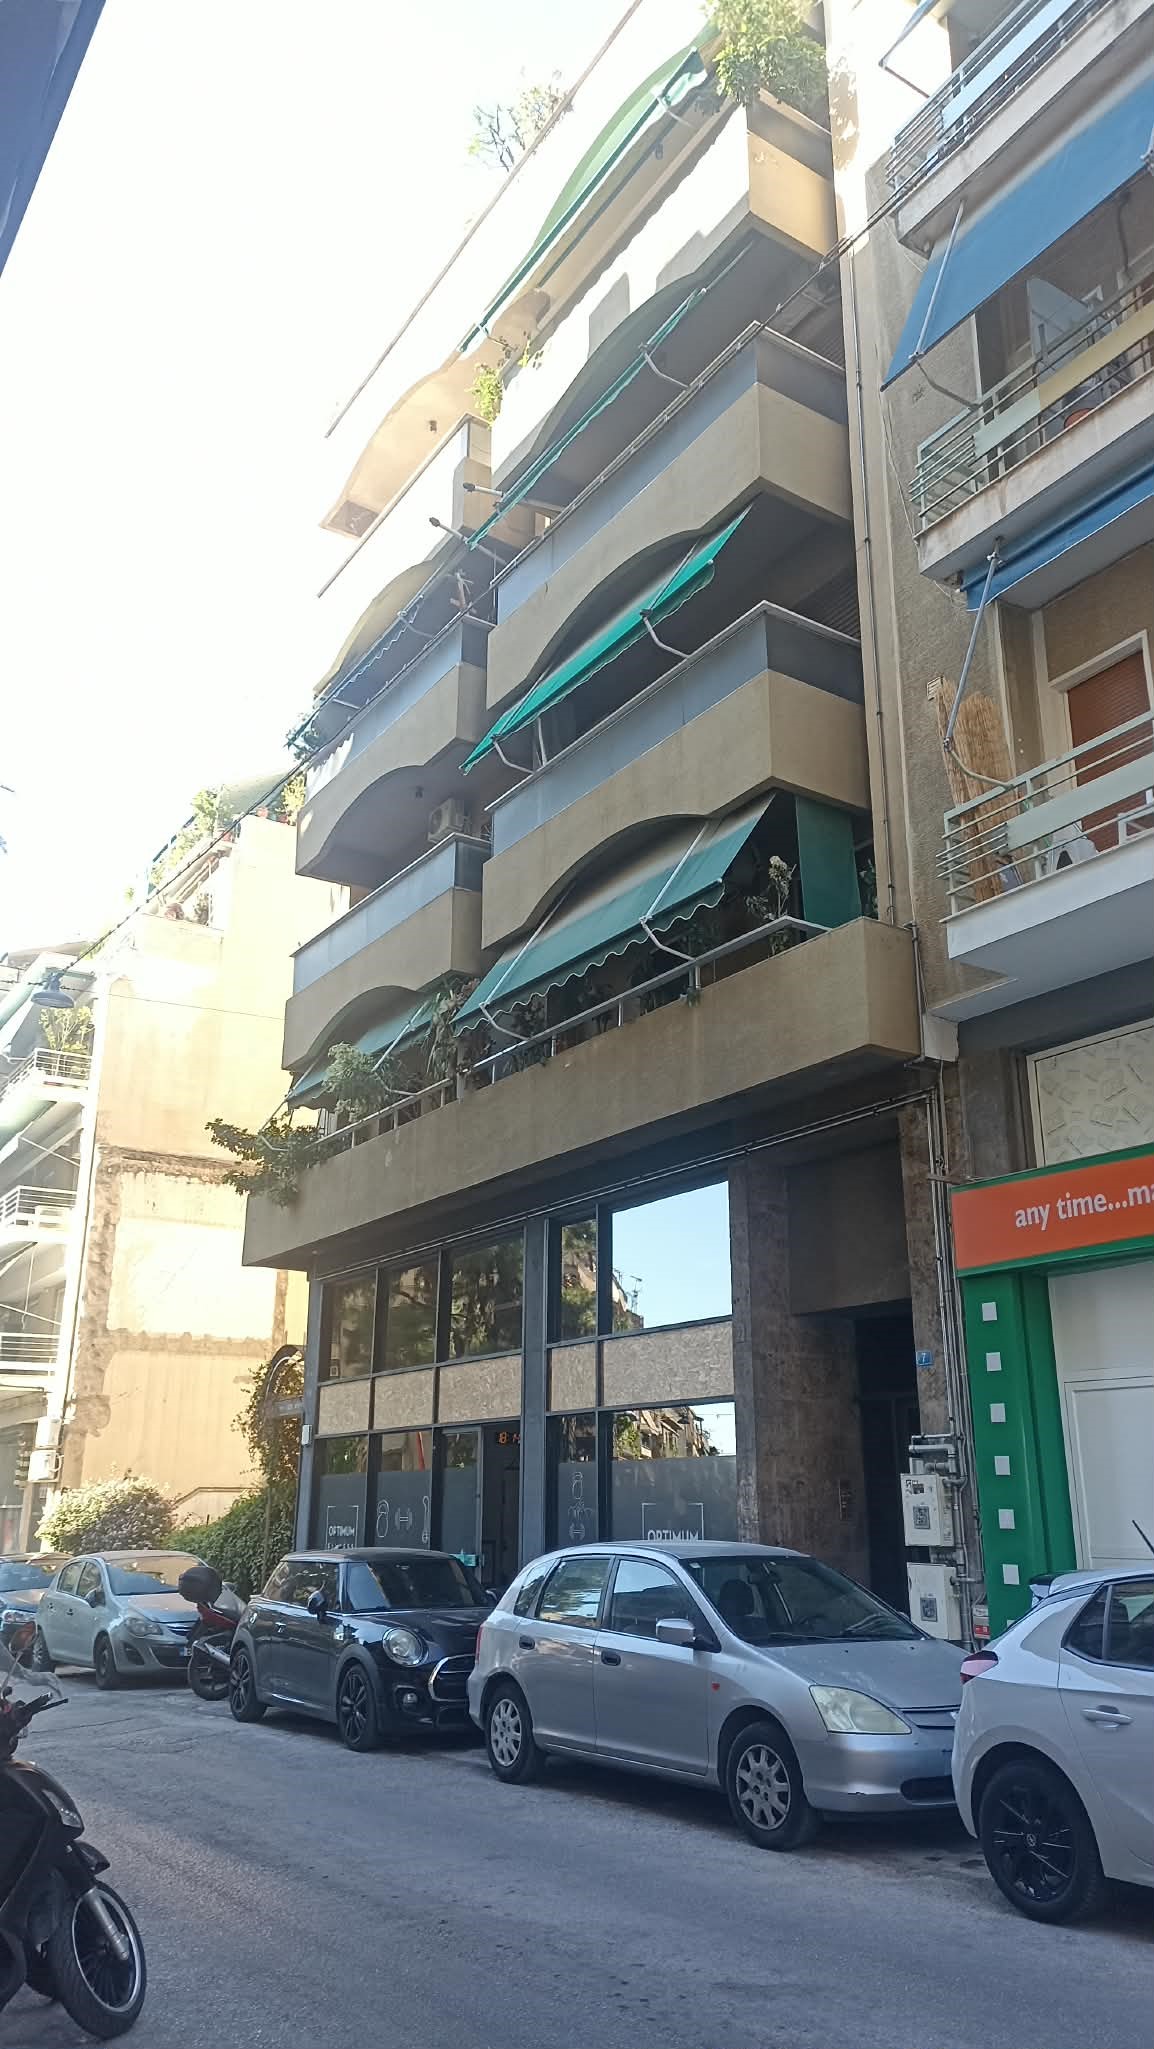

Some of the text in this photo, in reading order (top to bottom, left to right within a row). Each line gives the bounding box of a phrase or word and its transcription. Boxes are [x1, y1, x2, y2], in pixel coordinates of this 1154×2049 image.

[1015, 1204, 1050, 1231] any
[328, 1525, 355, 1537] OPTIMUM
[647, 1529, 699, 1541] OPTIMUM
